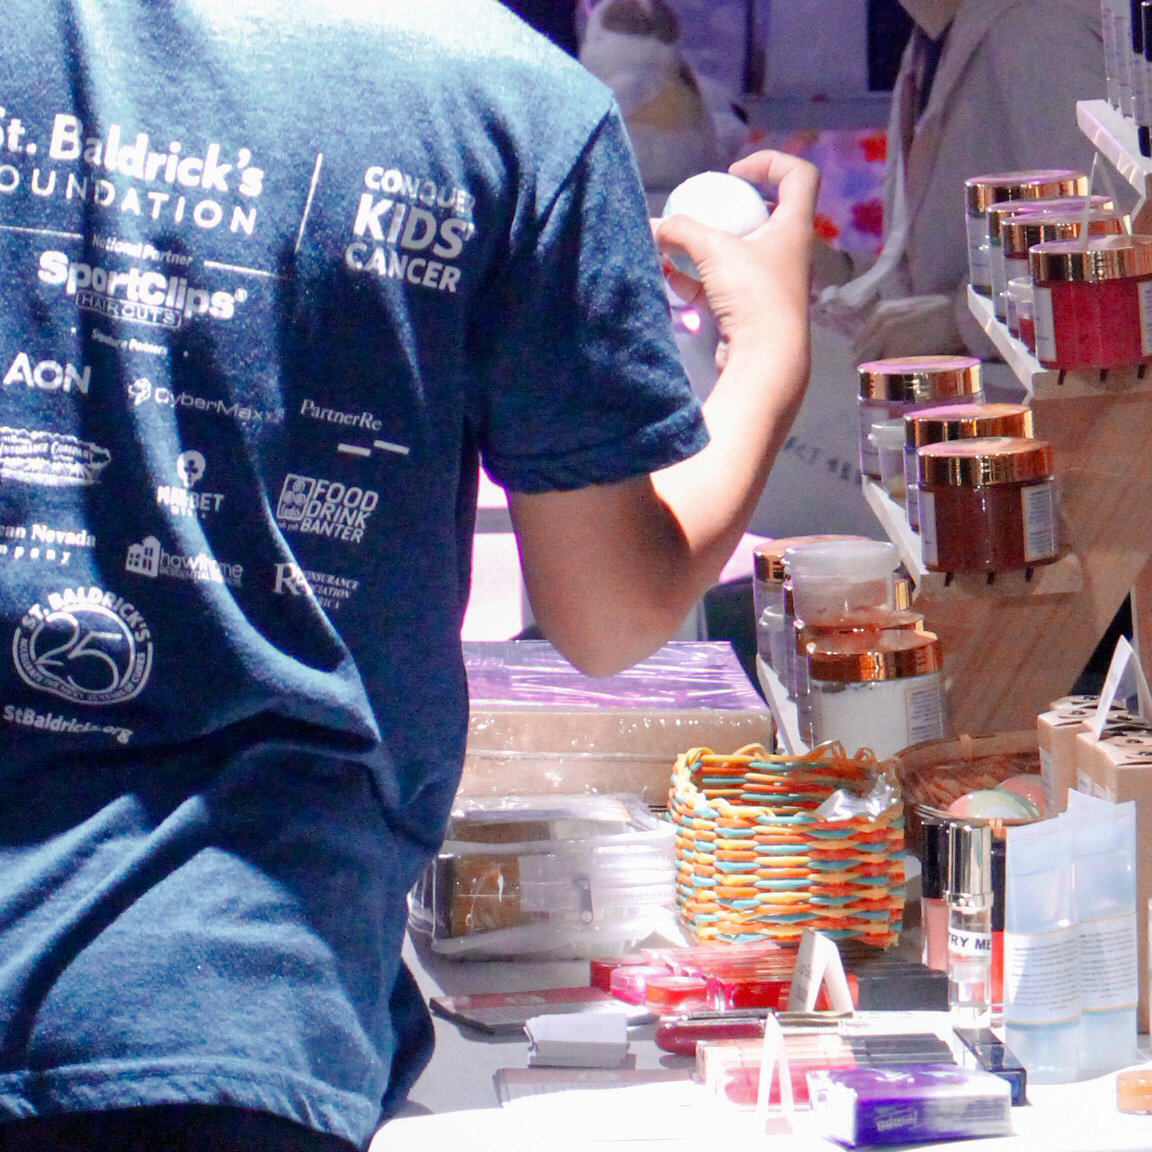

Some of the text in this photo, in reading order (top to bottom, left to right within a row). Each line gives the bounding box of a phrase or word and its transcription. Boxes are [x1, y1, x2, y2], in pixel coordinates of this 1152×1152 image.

[50, 113, 265, 197] Baldrick's
[0, 164, 258, 235] OUNDATION
[345, 242, 461, 293] CANCER
[80, 295, 177, 325] HAIRCUTS
[2, 352, 92, 394] AON
[301, 398, 383, 432] PartnerRe
[313, 479, 379, 512] FOOD
[300, 517, 364, 544] BANTER
[306, 499, 371, 529] DRINK
[31, 523, 96, 547] Nevada
[47, 586, 151, 643] BALDRICK'S
[948, 933, 970, 948] RY
